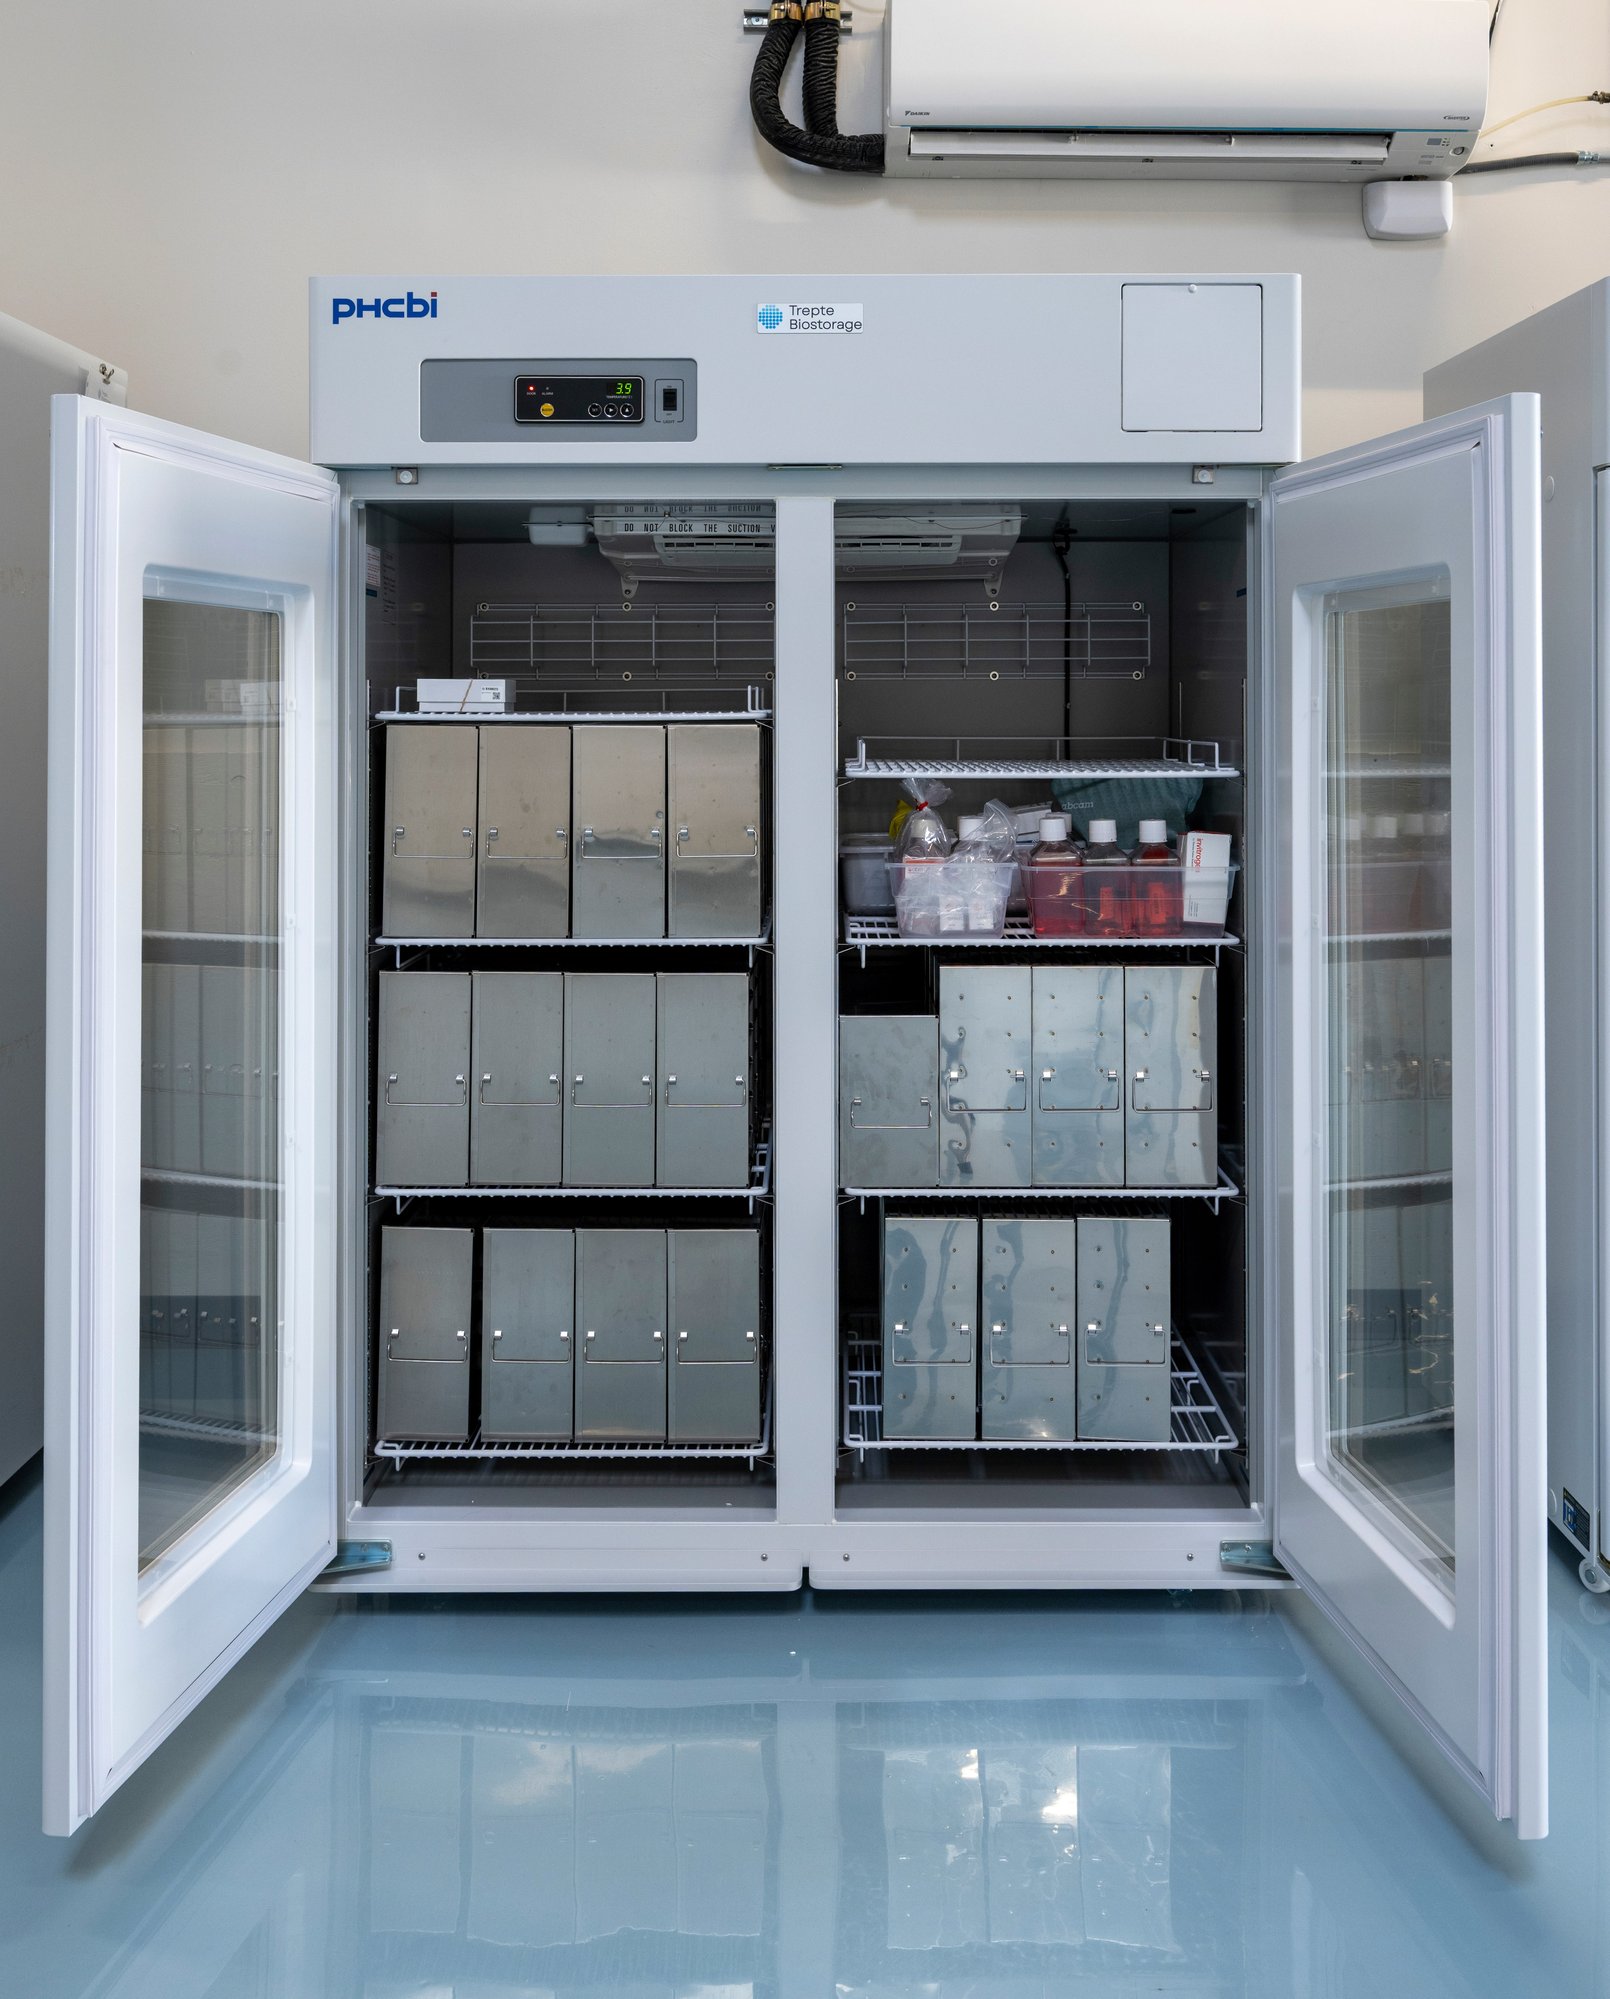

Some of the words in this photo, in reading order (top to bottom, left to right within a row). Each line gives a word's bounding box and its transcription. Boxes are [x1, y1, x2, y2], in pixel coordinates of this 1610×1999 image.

[789, 304, 835, 318] Trepte
[789, 318, 863, 333] Biostorage
[616, 382, 633, 395] 3.9
[624, 523, 634, 532] DO
[643, 523, 659, 532] NOT
[669, 523, 693, 532] BLOCK
[703, 523, 718, 532] THE
[727, 523, 761, 533] SUCTION
[1062, 801, 1094, 810] abcam
